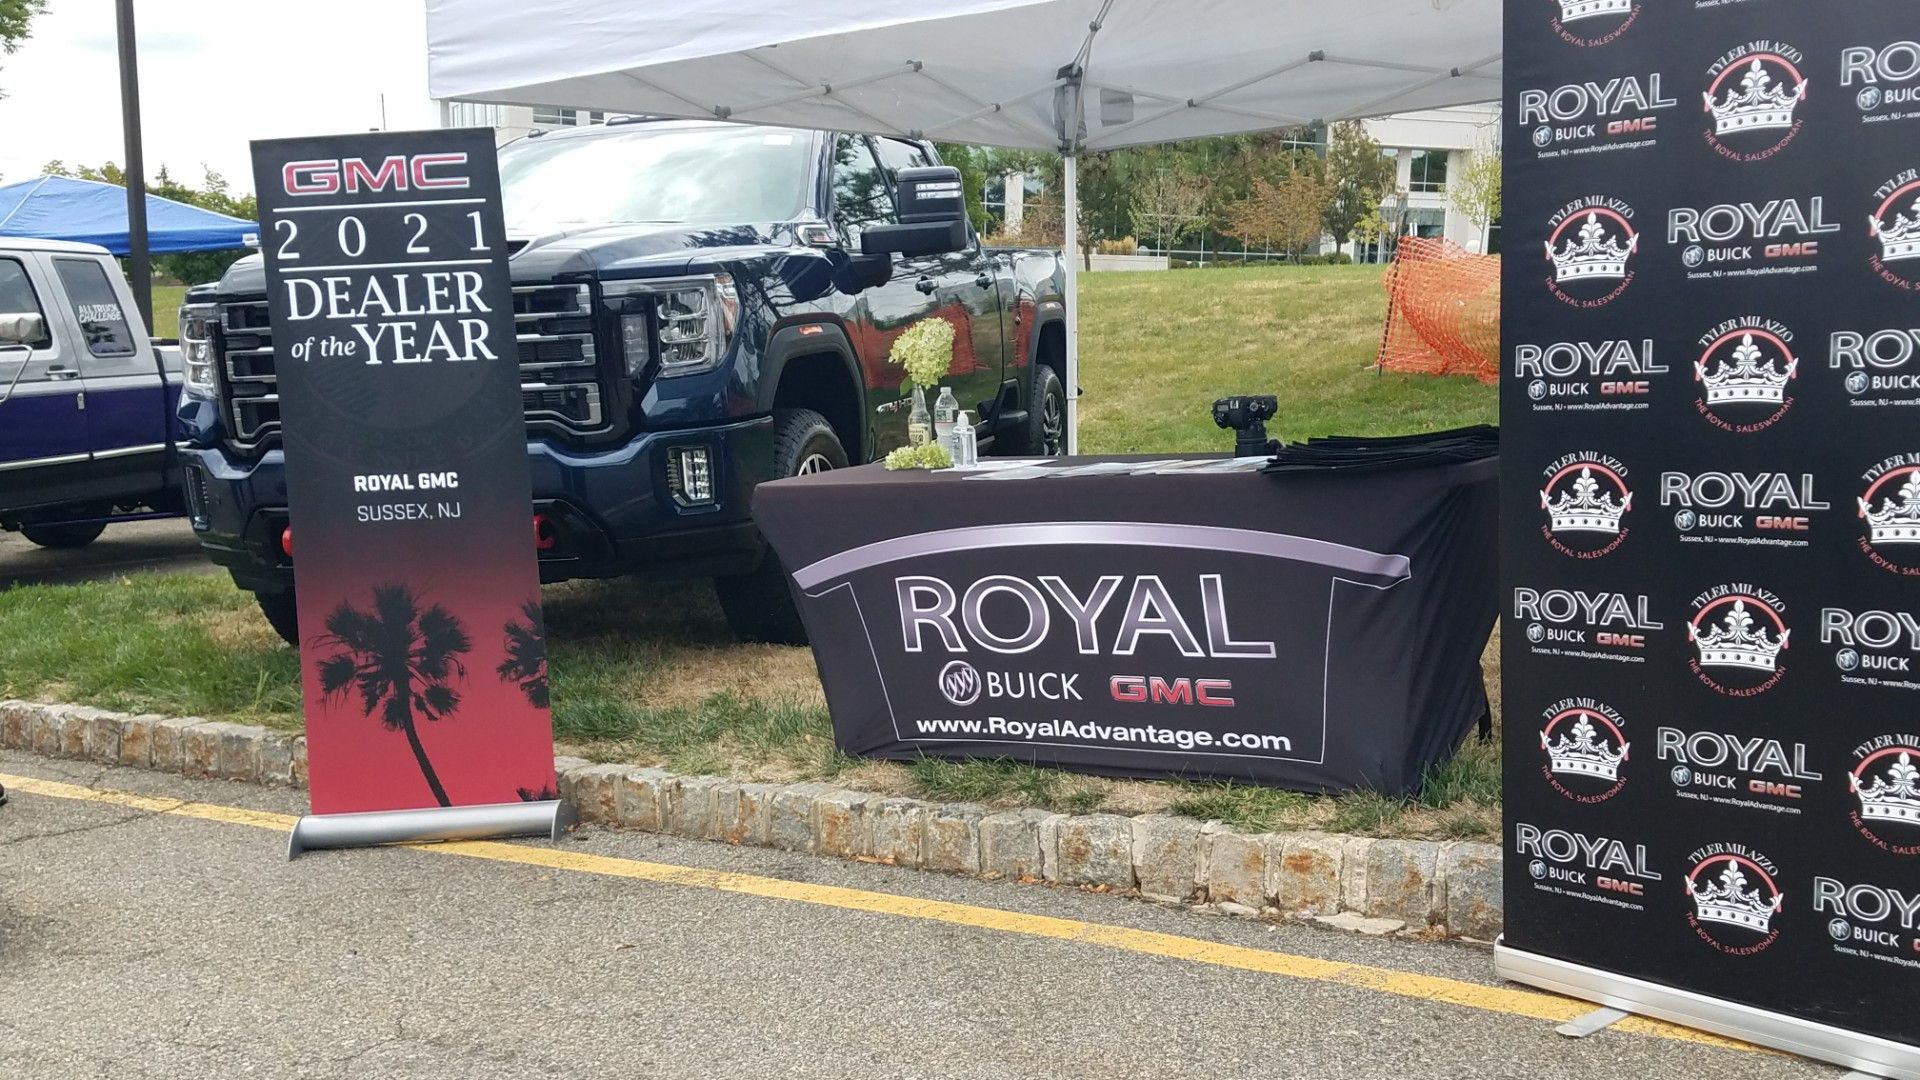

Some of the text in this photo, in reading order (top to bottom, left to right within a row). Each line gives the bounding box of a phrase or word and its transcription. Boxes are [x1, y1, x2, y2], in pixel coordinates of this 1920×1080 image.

[1550, 4, 1642, 47] THE ROYAL SALESWOMAN
[1706, 39, 1803, 77] TYLER MILAZZO
[1519, 73, 1677, 125] ROYAL
[1555, 116, 1657, 141] BUICK GMC
[1703, 118, 1804, 162] THE ROYAL SALESWOMAN
[282, 152, 470, 197] GMC
[1873, 168, 1918, 199] TYLER
[1548, 195, 1634, 227] TYLER MILAZZO
[1667, 196, 1840, 244] ROYAL
[1707, 241, 1818, 262] BUICK GMC
[1544, 270, 1636, 309] THE ROYAL SALESWOMAN
[1868, 253, 1884, 272] THE
[1881, 270, 1911, 290] ROYAL
[284, 271, 493, 321] DEALER
[291, 318, 498, 365] of the YEAR
[1699, 315, 1794, 347] TYLER MILAZZO
[1515, 339, 1670, 377] ROYAL
[1550, 380, 1650, 396] BUICK GMC
[1695, 396, 1795, 433] THE ROYAL SALESWOMAN
[353, 471, 459, 492] ROYAL GMC
[1543, 450, 1628, 478] TYLER MILAZZO
[1861, 454, 1905, 482] TYLER
[1660, 471, 1830, 510] ROYAL
[357, 502, 461, 522] SUSSEX, NJ
[1699, 514, 1809, 531] BUICK GMC
[1540, 523, 1630, 559] THE ROYAL SALESWOMAN
[1858, 535, 1872, 553] THE
[1869, 552, 1899, 573] ROYAL
[895, 572, 1276, 659] ROYAL
[1514, 587, 1664, 630] ROYAL
[1691, 582, 1786, 613] TYLER MILAZZO
[1547, 628, 1645, 648] BUICK GMC
[1687, 657, 1787, 697] THE ROYAL SALESWOMAN
[1861, 654, 1910, 672] BUICK
[986, 669, 1235, 708] BUICK GMC
[1542, 696, 1625, 728] TYLER MILAZZO
[916, 716, 1291, 752] www.RoyalAdvantage.com
[1852, 734, 1894, 759] TYLER
[1657, 726, 1823, 781] ROYAL
[1541, 764, 1628, 804] THE ROYAL SALESWOMAN
[1694, 771, 1802, 798] BUICK GMC
[1849, 810, 1863, 828] THE
[1860, 827, 1888, 851] ROYAL
[1516, 822, 1662, 881] ROYAL
[1687, 841, 1779, 878] TYLER MILAZZO
[1549, 866, 1644, 897] BUICK GMC
[1685, 910, 1780, 956] THE ROYAL SALESWOMAN
[1854, 926, 1900, 948] BUICK
